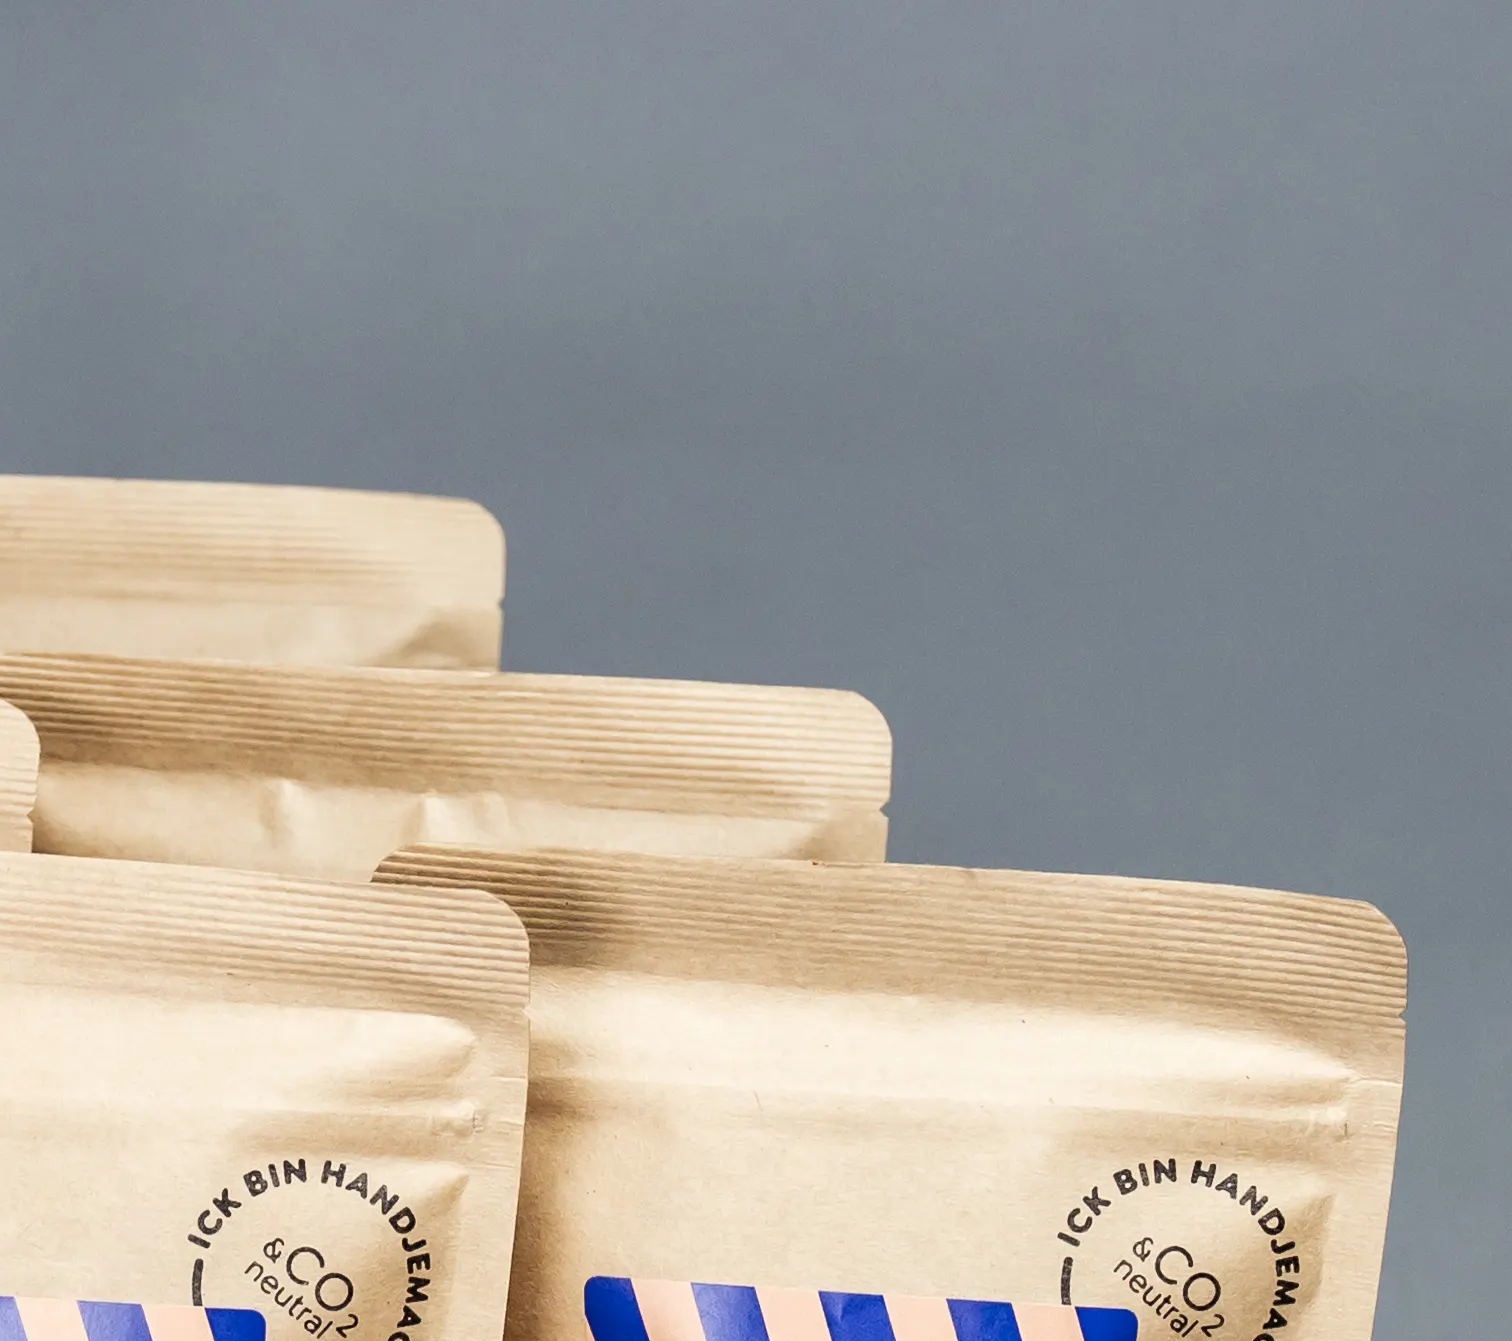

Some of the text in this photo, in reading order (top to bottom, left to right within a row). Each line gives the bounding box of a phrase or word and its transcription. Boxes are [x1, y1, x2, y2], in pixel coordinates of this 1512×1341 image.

[188, 1188, 242, 1249] ICK
[243, 1159, 307, 1197] BIN
[1057, 1186, 1111, 1247] ICK
[1113, 1158, 1177, 1195] BIN
[244, 1260, 334, 1340] neutral
[1113, 1259, 1199, 1338] neutral
